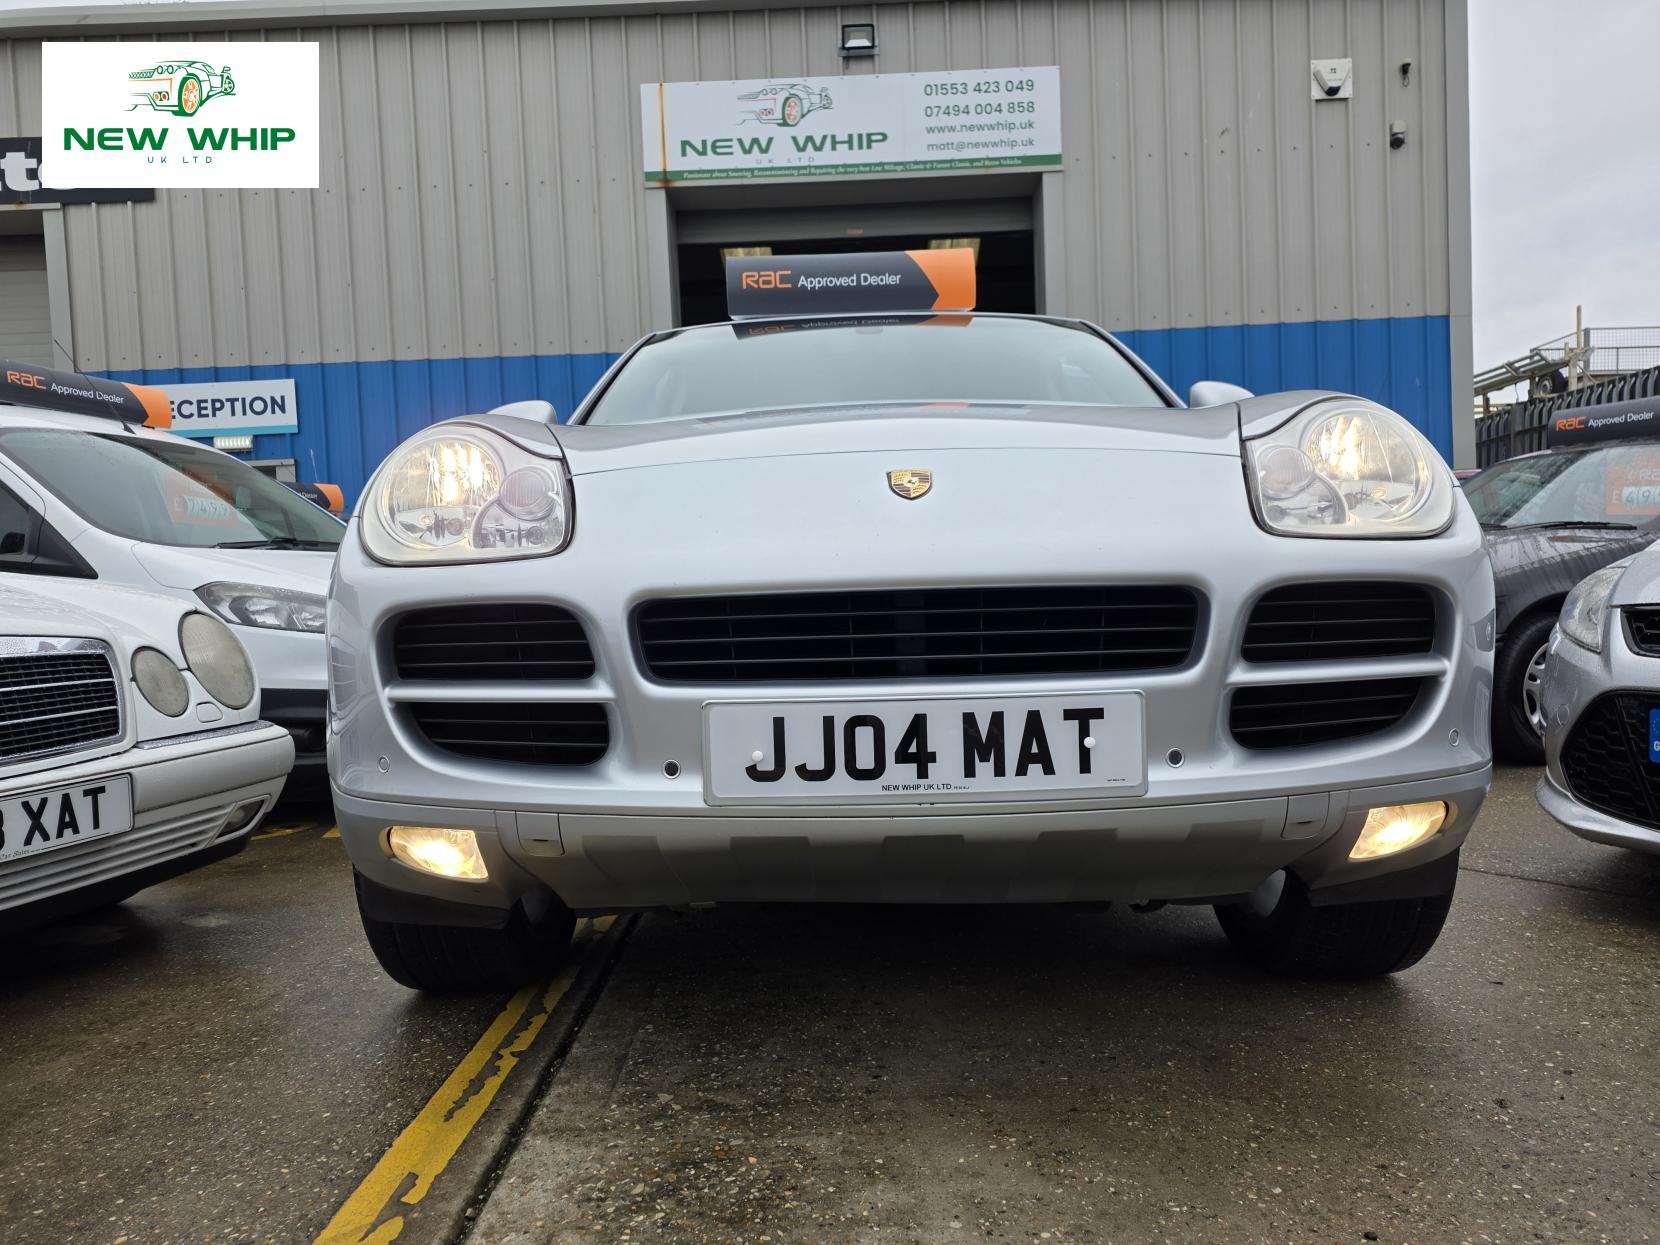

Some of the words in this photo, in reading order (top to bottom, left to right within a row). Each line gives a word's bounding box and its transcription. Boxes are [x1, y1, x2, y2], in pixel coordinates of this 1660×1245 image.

[924, 82, 968, 96] 01553
[973, 81, 1000, 94] 423
[1005, 79, 1034, 92] 049
[924, 104, 970, 118] 07494
[974, 103, 1003, 115] 004
[1007, 101, 1035, 114] 858
[925, 120, 1035, 134] www.newwhip.uk
[680, 136, 774, 157] NEW
[791, 132, 888, 153] WHIP
[927, 137, 1035, 152] matt@newwhip.uk
[798, 274, 857, 290] Approved
[860, 272, 901, 286] Dealer
[51, 382, 94, 399] Approved
[96, 391, 124, 404] Dealer
[170, 395, 286, 420] CEPTION
[1588, 415, 1625, 428] Approved
[1627, 411, 1655, 422] Dealer
[962, 707, 1105, 779] MAT
[881, 784, 900, 792] NEW
[901, 783, 922, 791] WHIP
[21, 785, 106, 847] XAT
